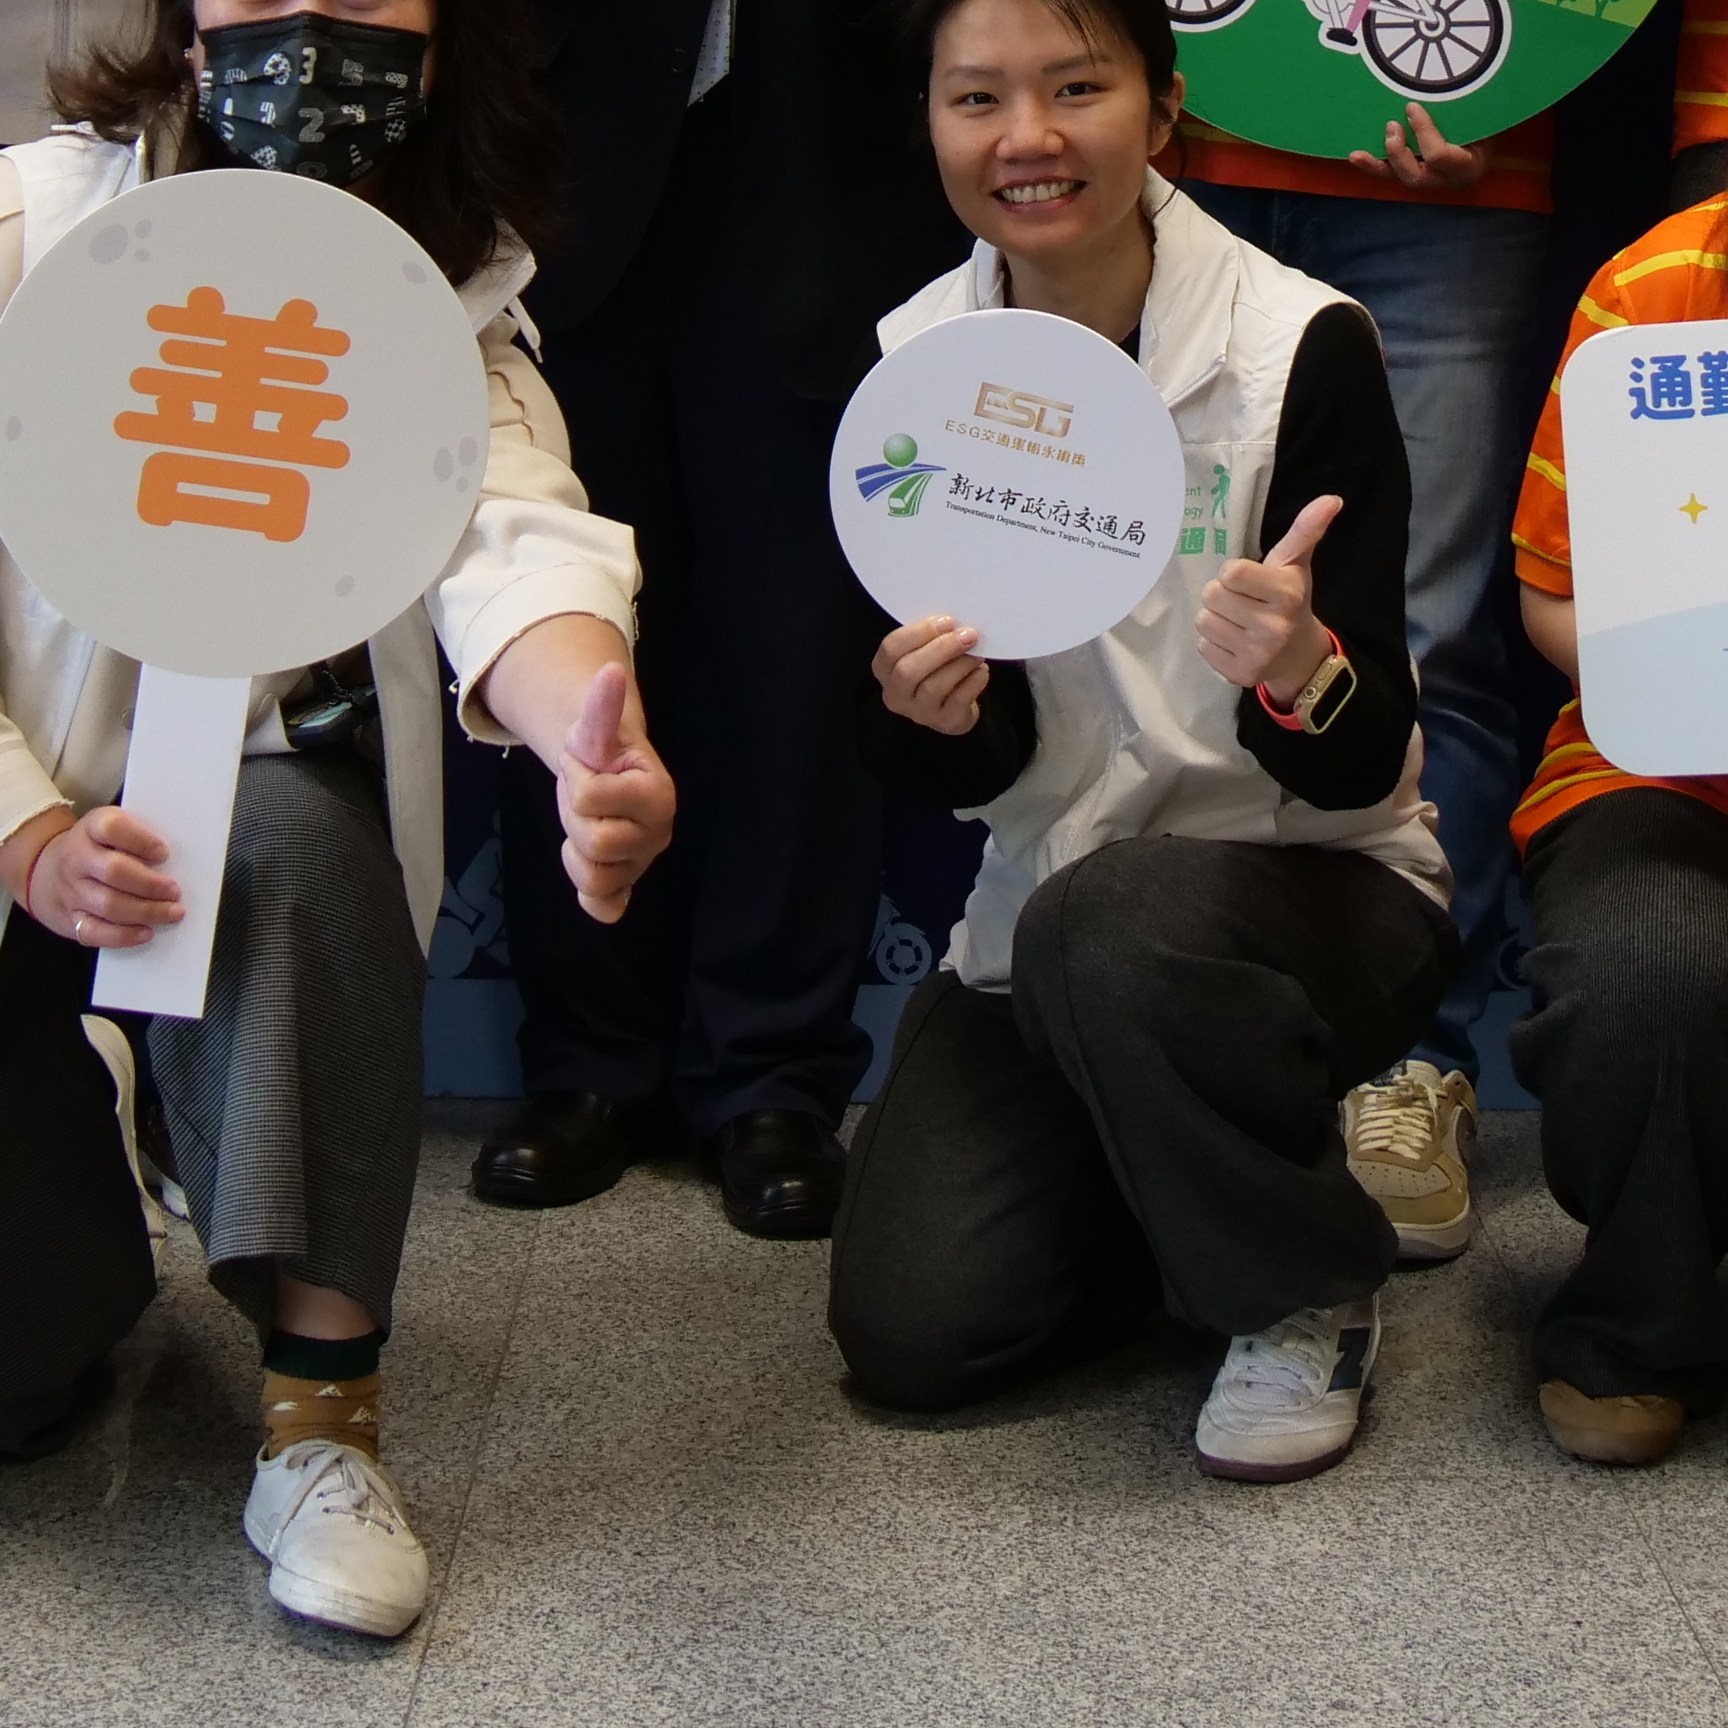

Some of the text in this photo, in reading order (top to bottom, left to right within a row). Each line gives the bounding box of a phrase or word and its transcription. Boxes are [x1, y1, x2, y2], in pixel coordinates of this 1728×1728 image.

[113, 286, 351, 543] 善
[946, 501, 995, 520] Transportation
[1040, 526, 1056, 536] New
[1059, 530, 1080, 543] Taipei
[1081, 536, 1096, 549] City
[1098, 541, 1141, 558] Government
[949, 473, 1146, 545] 新北市政府交通局
